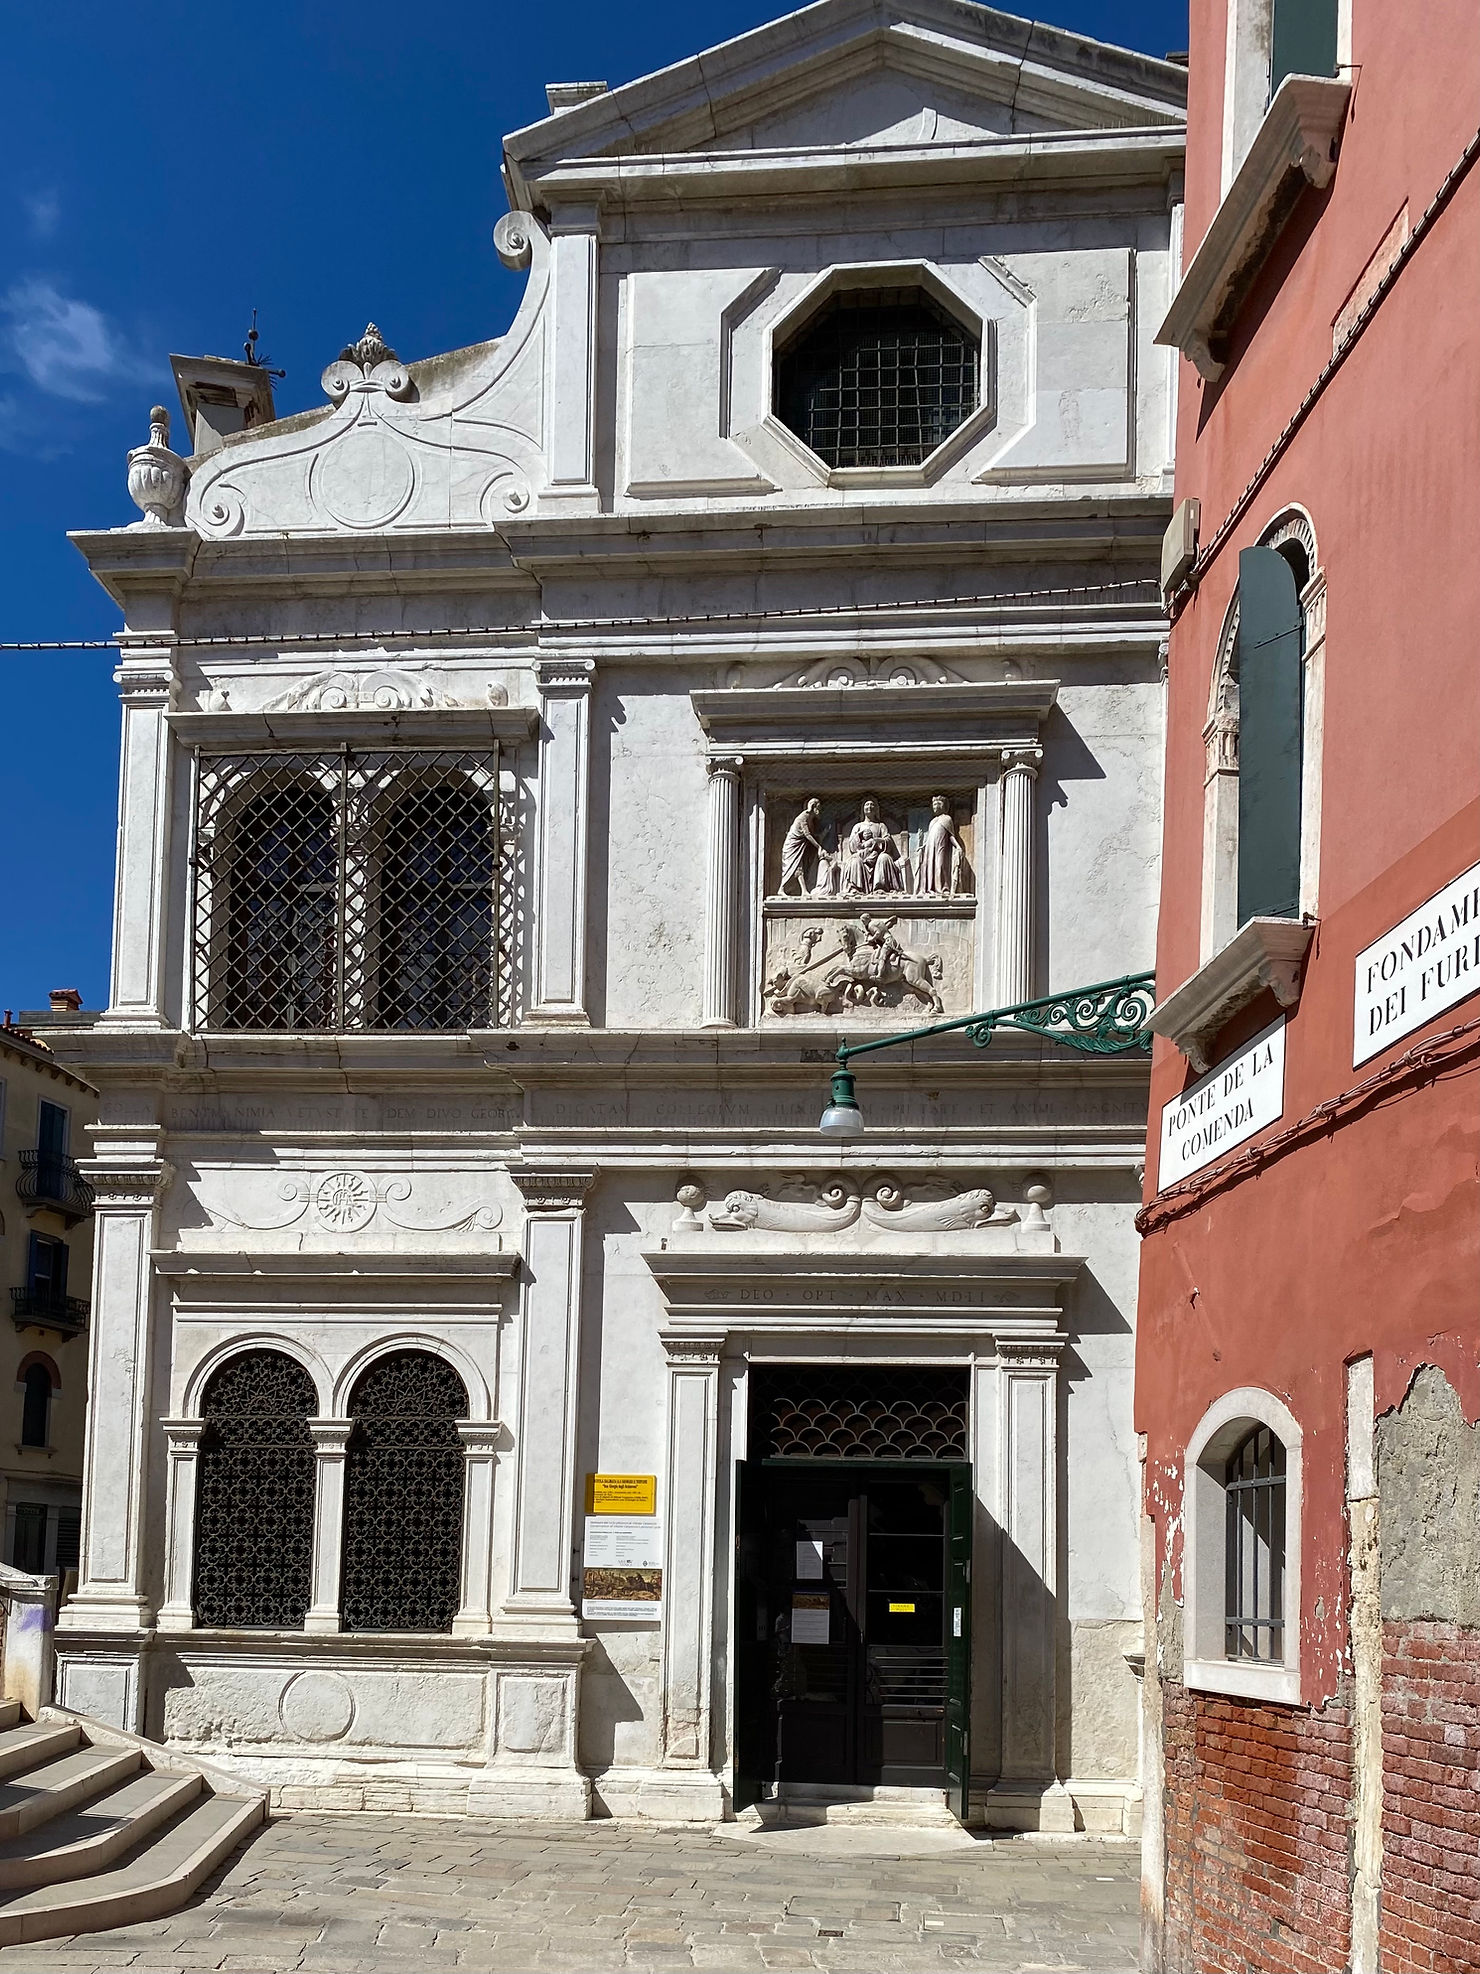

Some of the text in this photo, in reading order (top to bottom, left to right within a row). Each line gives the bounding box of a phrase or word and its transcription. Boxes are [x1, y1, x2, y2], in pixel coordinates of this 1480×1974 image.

[1369, 986, 1406, 1036] DEI
[1169, 1043, 1274, 1137] PONTE DE LA
[1182, 1098, 1254, 1161] COMENDA
[740, 1289, 774, 1300] DEO
[803, 1289, 836, 1301] OPT
[865, 1290, 905, 1302] MAX
